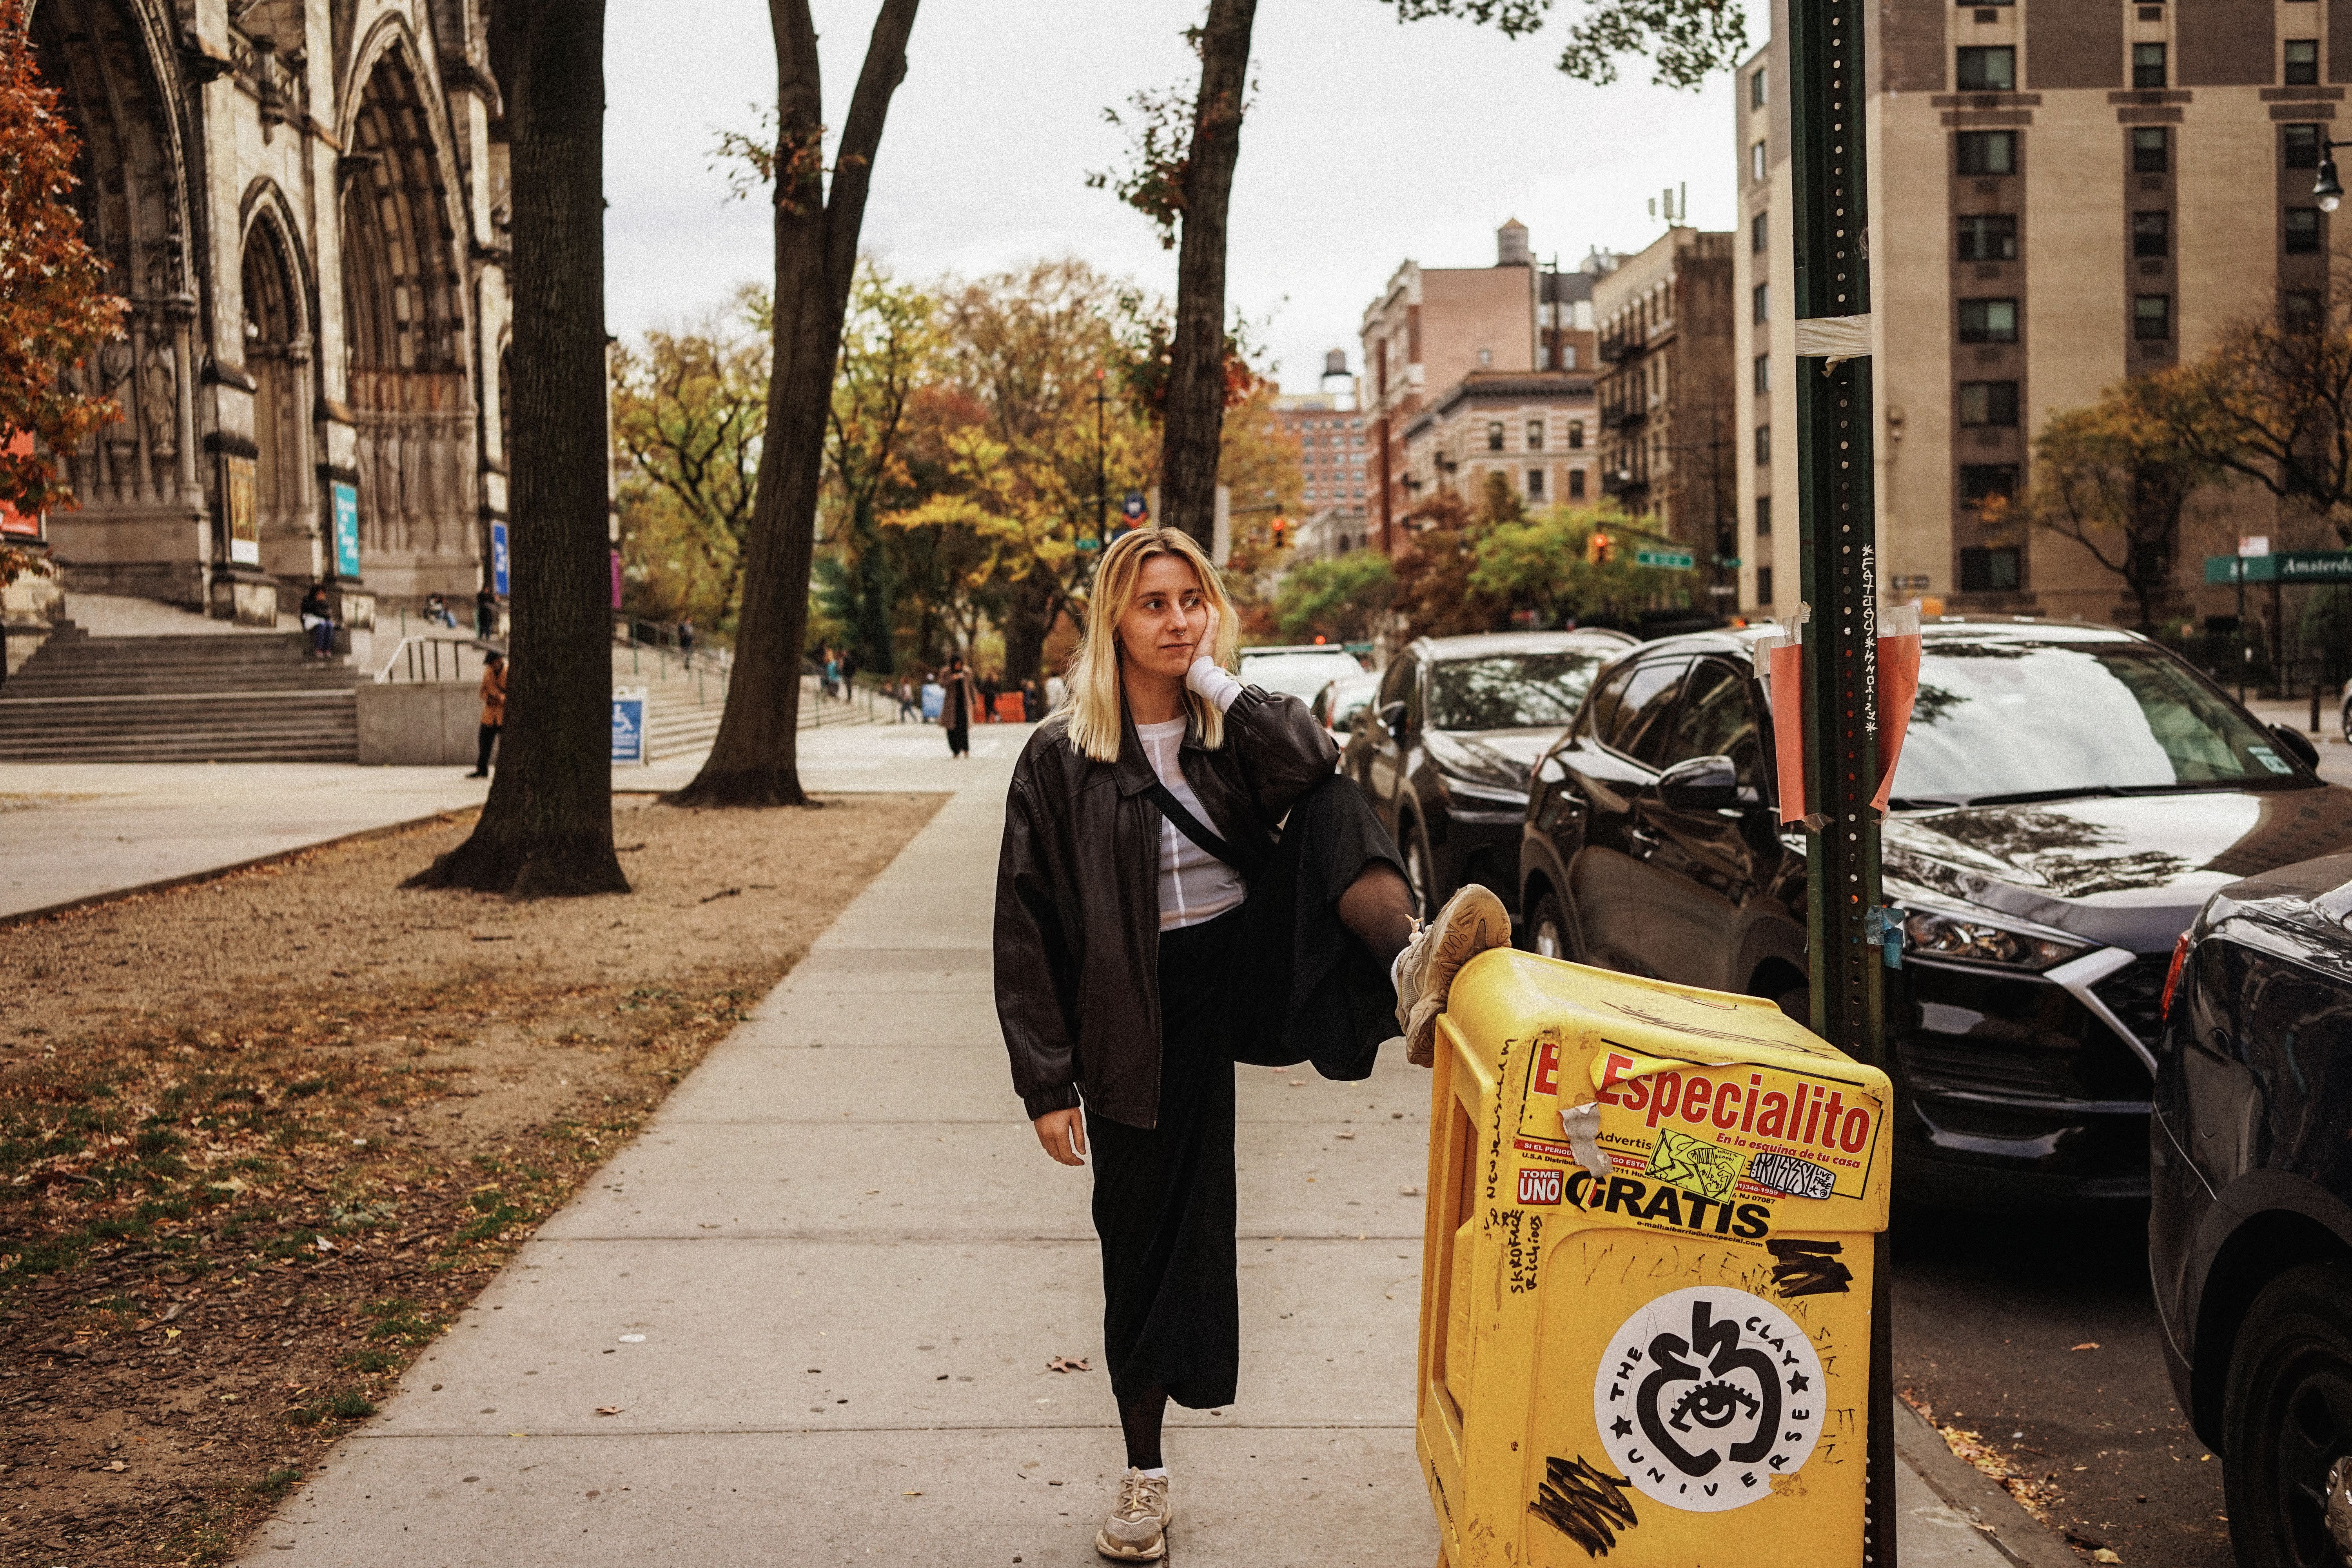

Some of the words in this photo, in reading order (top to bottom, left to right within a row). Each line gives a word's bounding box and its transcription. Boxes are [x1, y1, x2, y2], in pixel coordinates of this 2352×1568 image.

[2283, 556, 2352, 575] Amsterd
[1595, 1051, 1871, 1154] Especialito
[1595, 1131, 1655, 1150] Advertis
[1522, 1152, 1542, 1161] U.S.A
[1716, 1132, 1731, 1144] En
[1734, 1136, 1747, 1147] la
[1749, 1141, 1797, 1157] esquina
[1799, 1149, 1814, 1159] de
[1816, 1152, 1830, 1163] tu
[1832, 1156, 1861, 1169] casa
[1626, 1159, 1646, 1169] ESTA
[1815, 1167, 1832, 1180] LIVE
[1521, 1170, 1560, 1178] TOME
[1813, 1177, 1832, 1189] FREE
[1519, 1178, 1560, 1201] UNO
[1565, 1170, 1771, 1240] GRATIS
[1752, 1195, 1776, 1205] 07087
[1610, 1347, 1642, 1401] THE
[1745, 1316, 1800, 1367] CLAY
[1627, 1408, 1810, 1496] UNIVERSE
